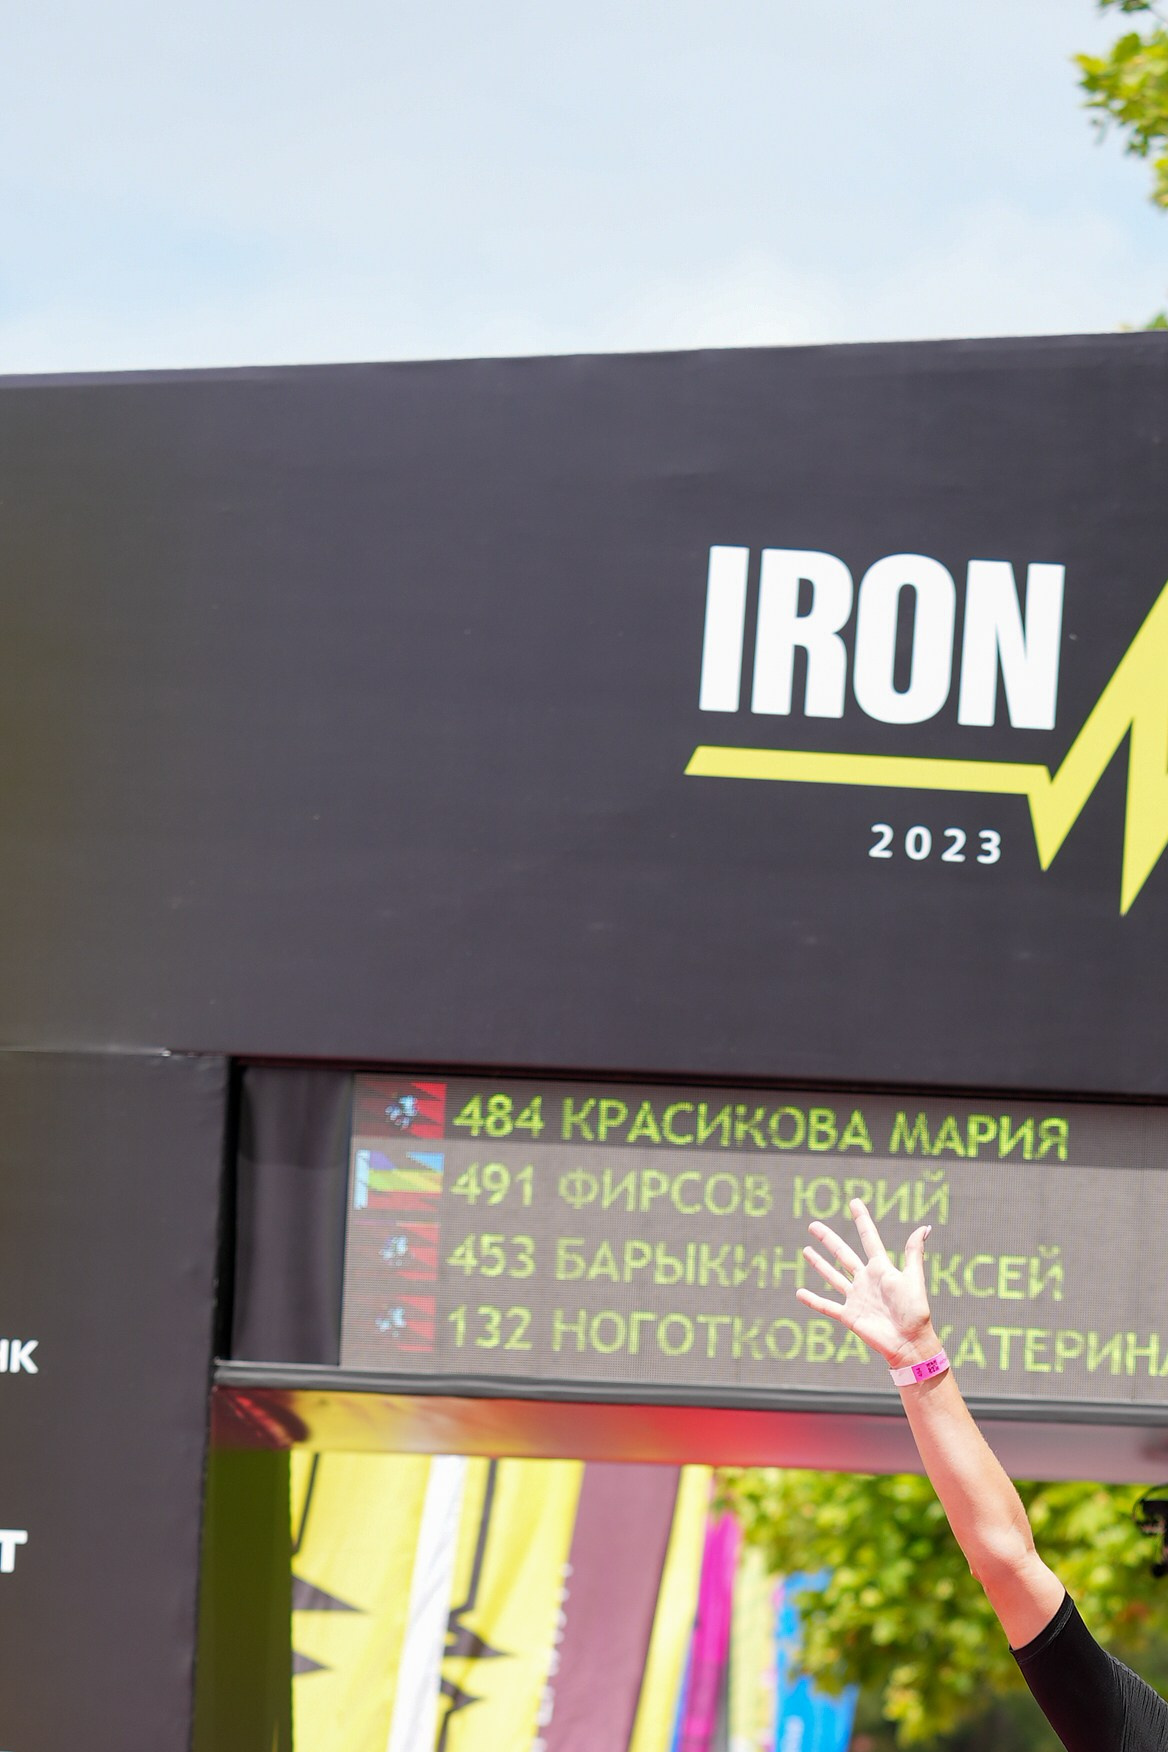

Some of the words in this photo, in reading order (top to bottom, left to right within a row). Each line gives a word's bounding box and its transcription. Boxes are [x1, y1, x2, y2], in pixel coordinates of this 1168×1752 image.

[698, 544, 1066, 731] IRON
[868, 823, 1002, 866] 2023
[453, 1093, 546, 1139] 484
[561, 1096, 872, 1153] КРАСИКОВА
[888, 1109, 1069, 1161] МАРИЯ
[450, 1161, 535, 1208] 491
[558, 1167, 773, 1218] ФИРСОВ
[446, 1232, 537, 1280] 453
[554, 1237, 806, 1290] БАРЫКИН
[447, 1304, 533, 1351] 132
